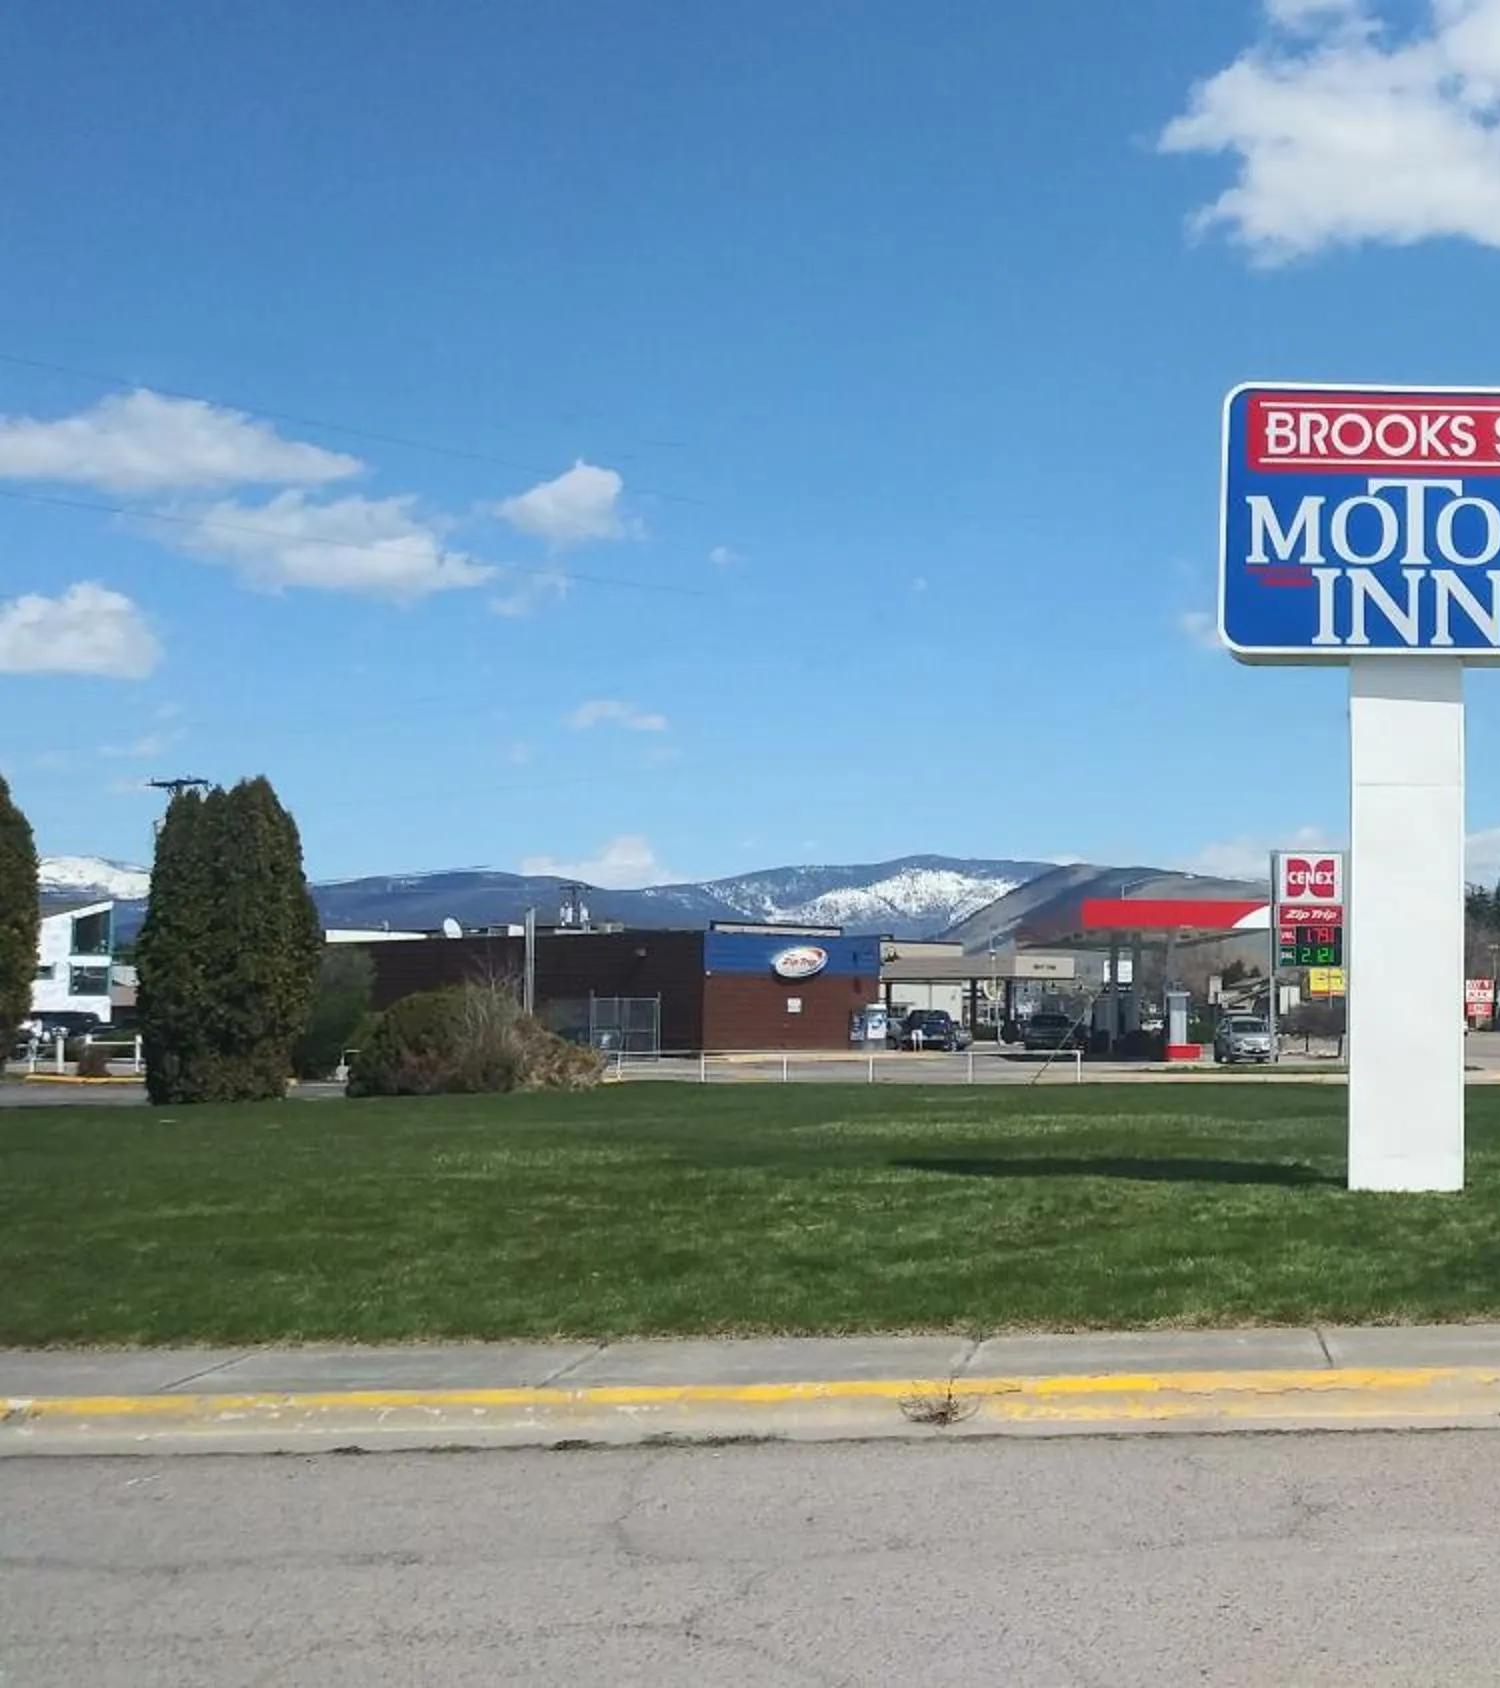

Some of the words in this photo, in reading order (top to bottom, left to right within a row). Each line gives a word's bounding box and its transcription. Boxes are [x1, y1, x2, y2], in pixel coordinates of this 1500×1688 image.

[1265, 411, 1476, 457] BROOKS
[1289, 871, 1334, 885] CENEX
[1285, 909, 1310, 920] Zip
[1311, 909, 1337, 920] Trip
